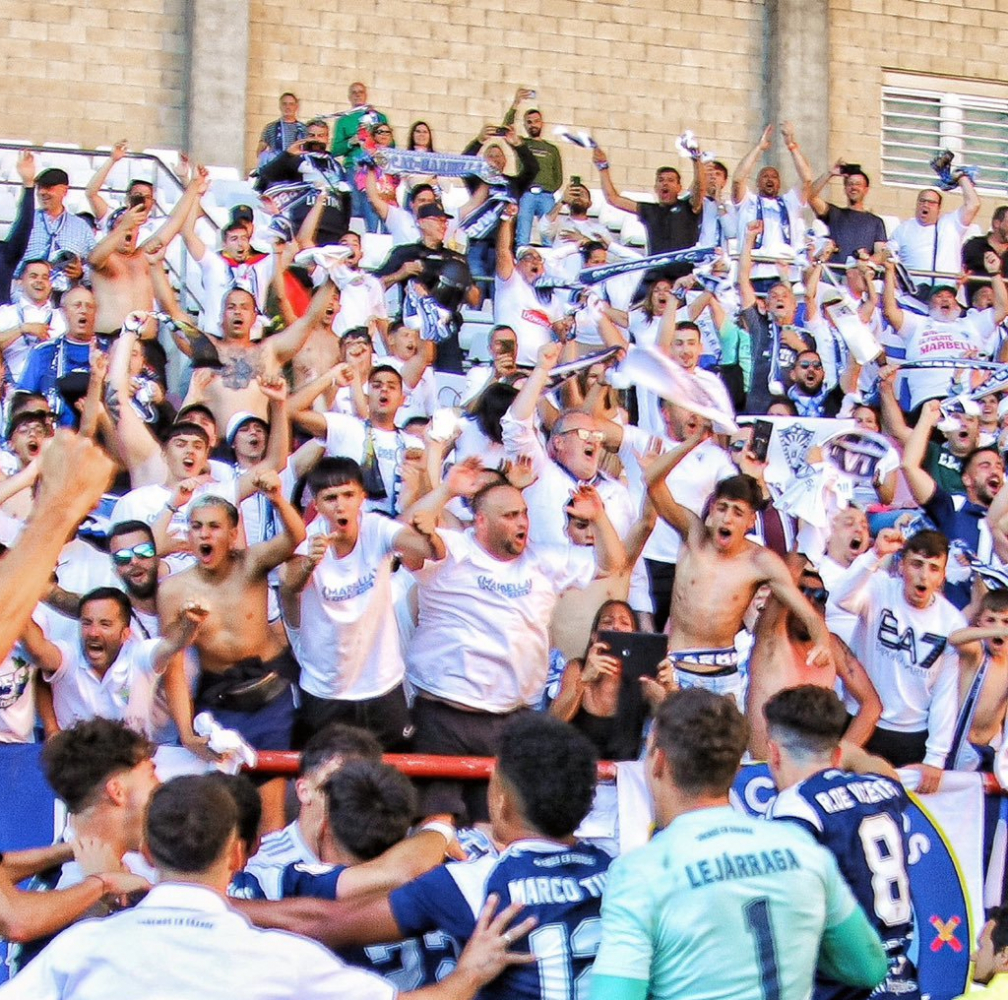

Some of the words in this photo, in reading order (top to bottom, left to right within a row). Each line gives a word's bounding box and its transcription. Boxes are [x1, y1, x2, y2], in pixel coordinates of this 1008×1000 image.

[877, 608, 947, 669] EA7
[508, 875, 584, 906] MARCO
[685, 849, 801, 889] LEJÁRRAGA
[858, 811, 911, 927] 8
